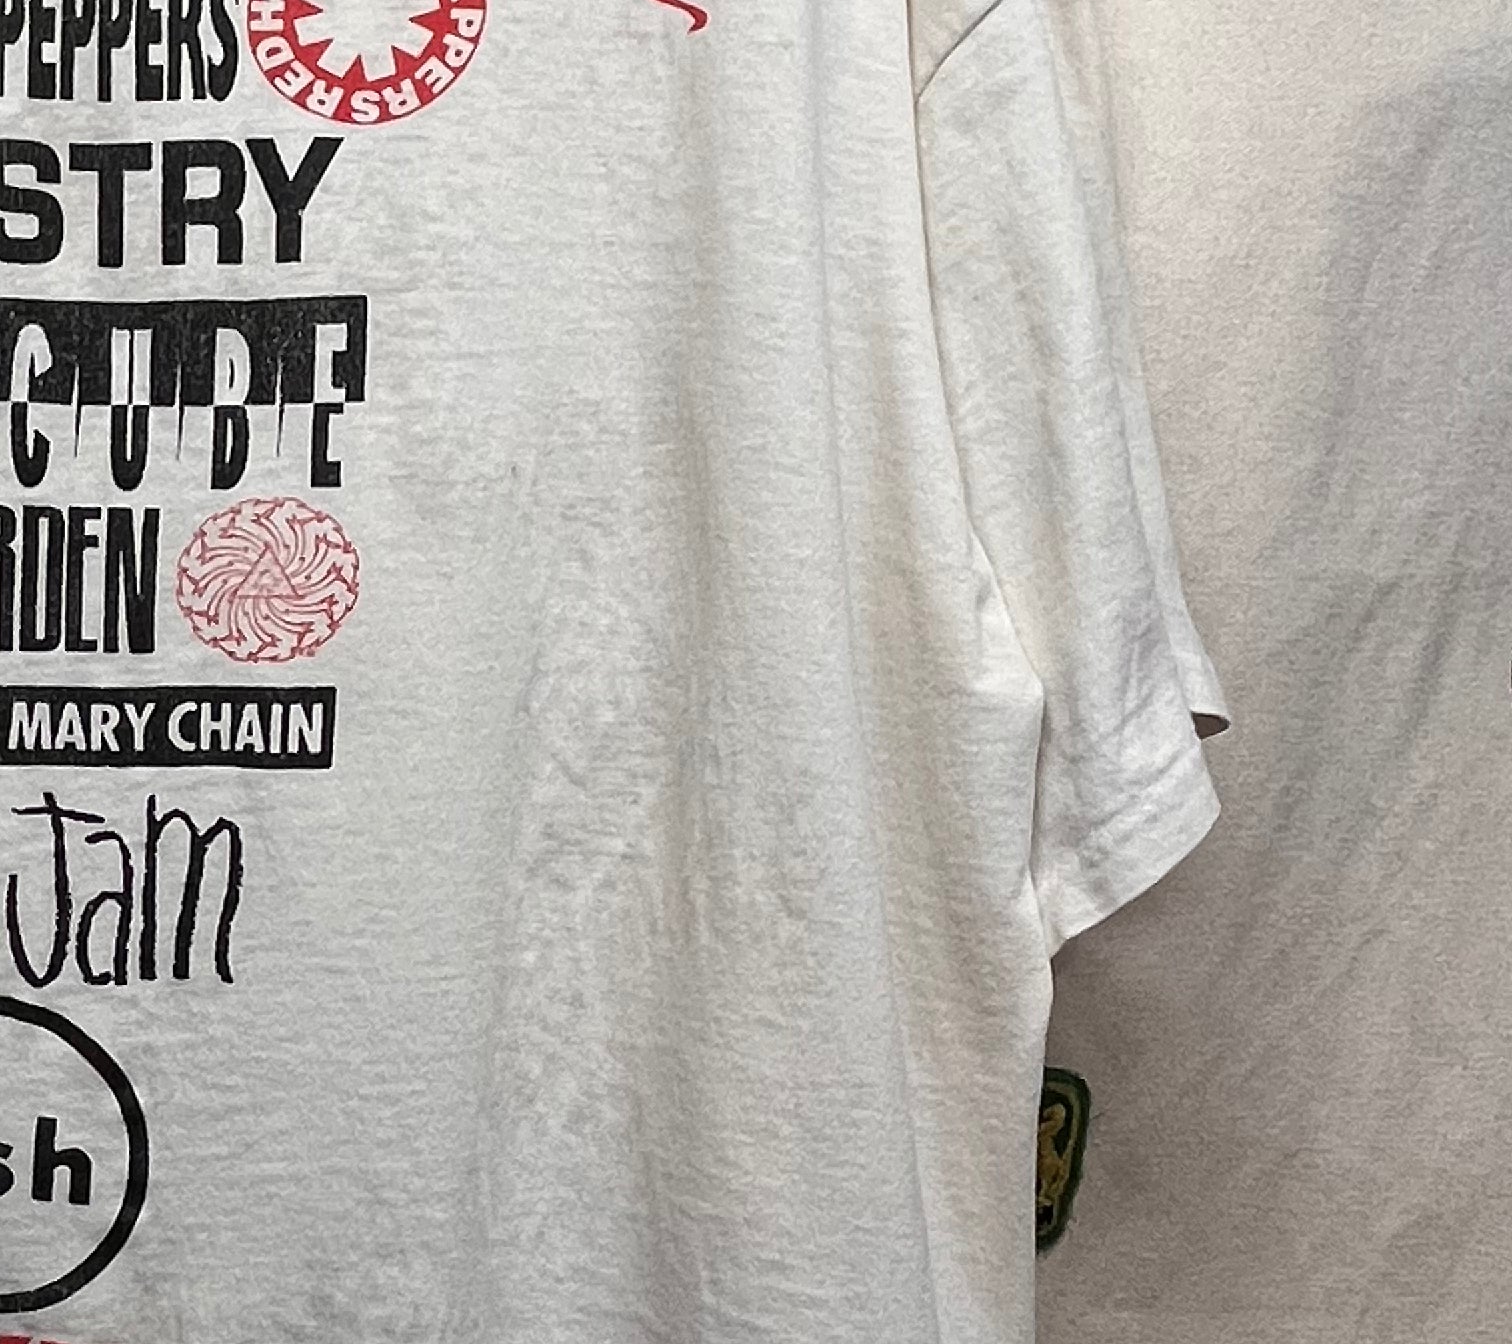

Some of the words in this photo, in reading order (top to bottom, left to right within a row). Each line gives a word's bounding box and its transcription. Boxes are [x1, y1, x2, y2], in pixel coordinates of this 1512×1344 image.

[255, 36, 344, 119] RED
[8, 320, 350, 492] CUBE
[7, 699, 159, 754] MARY
[167, 701, 324, 755] CHAIN
[5, 791, 244, 988] Jam
